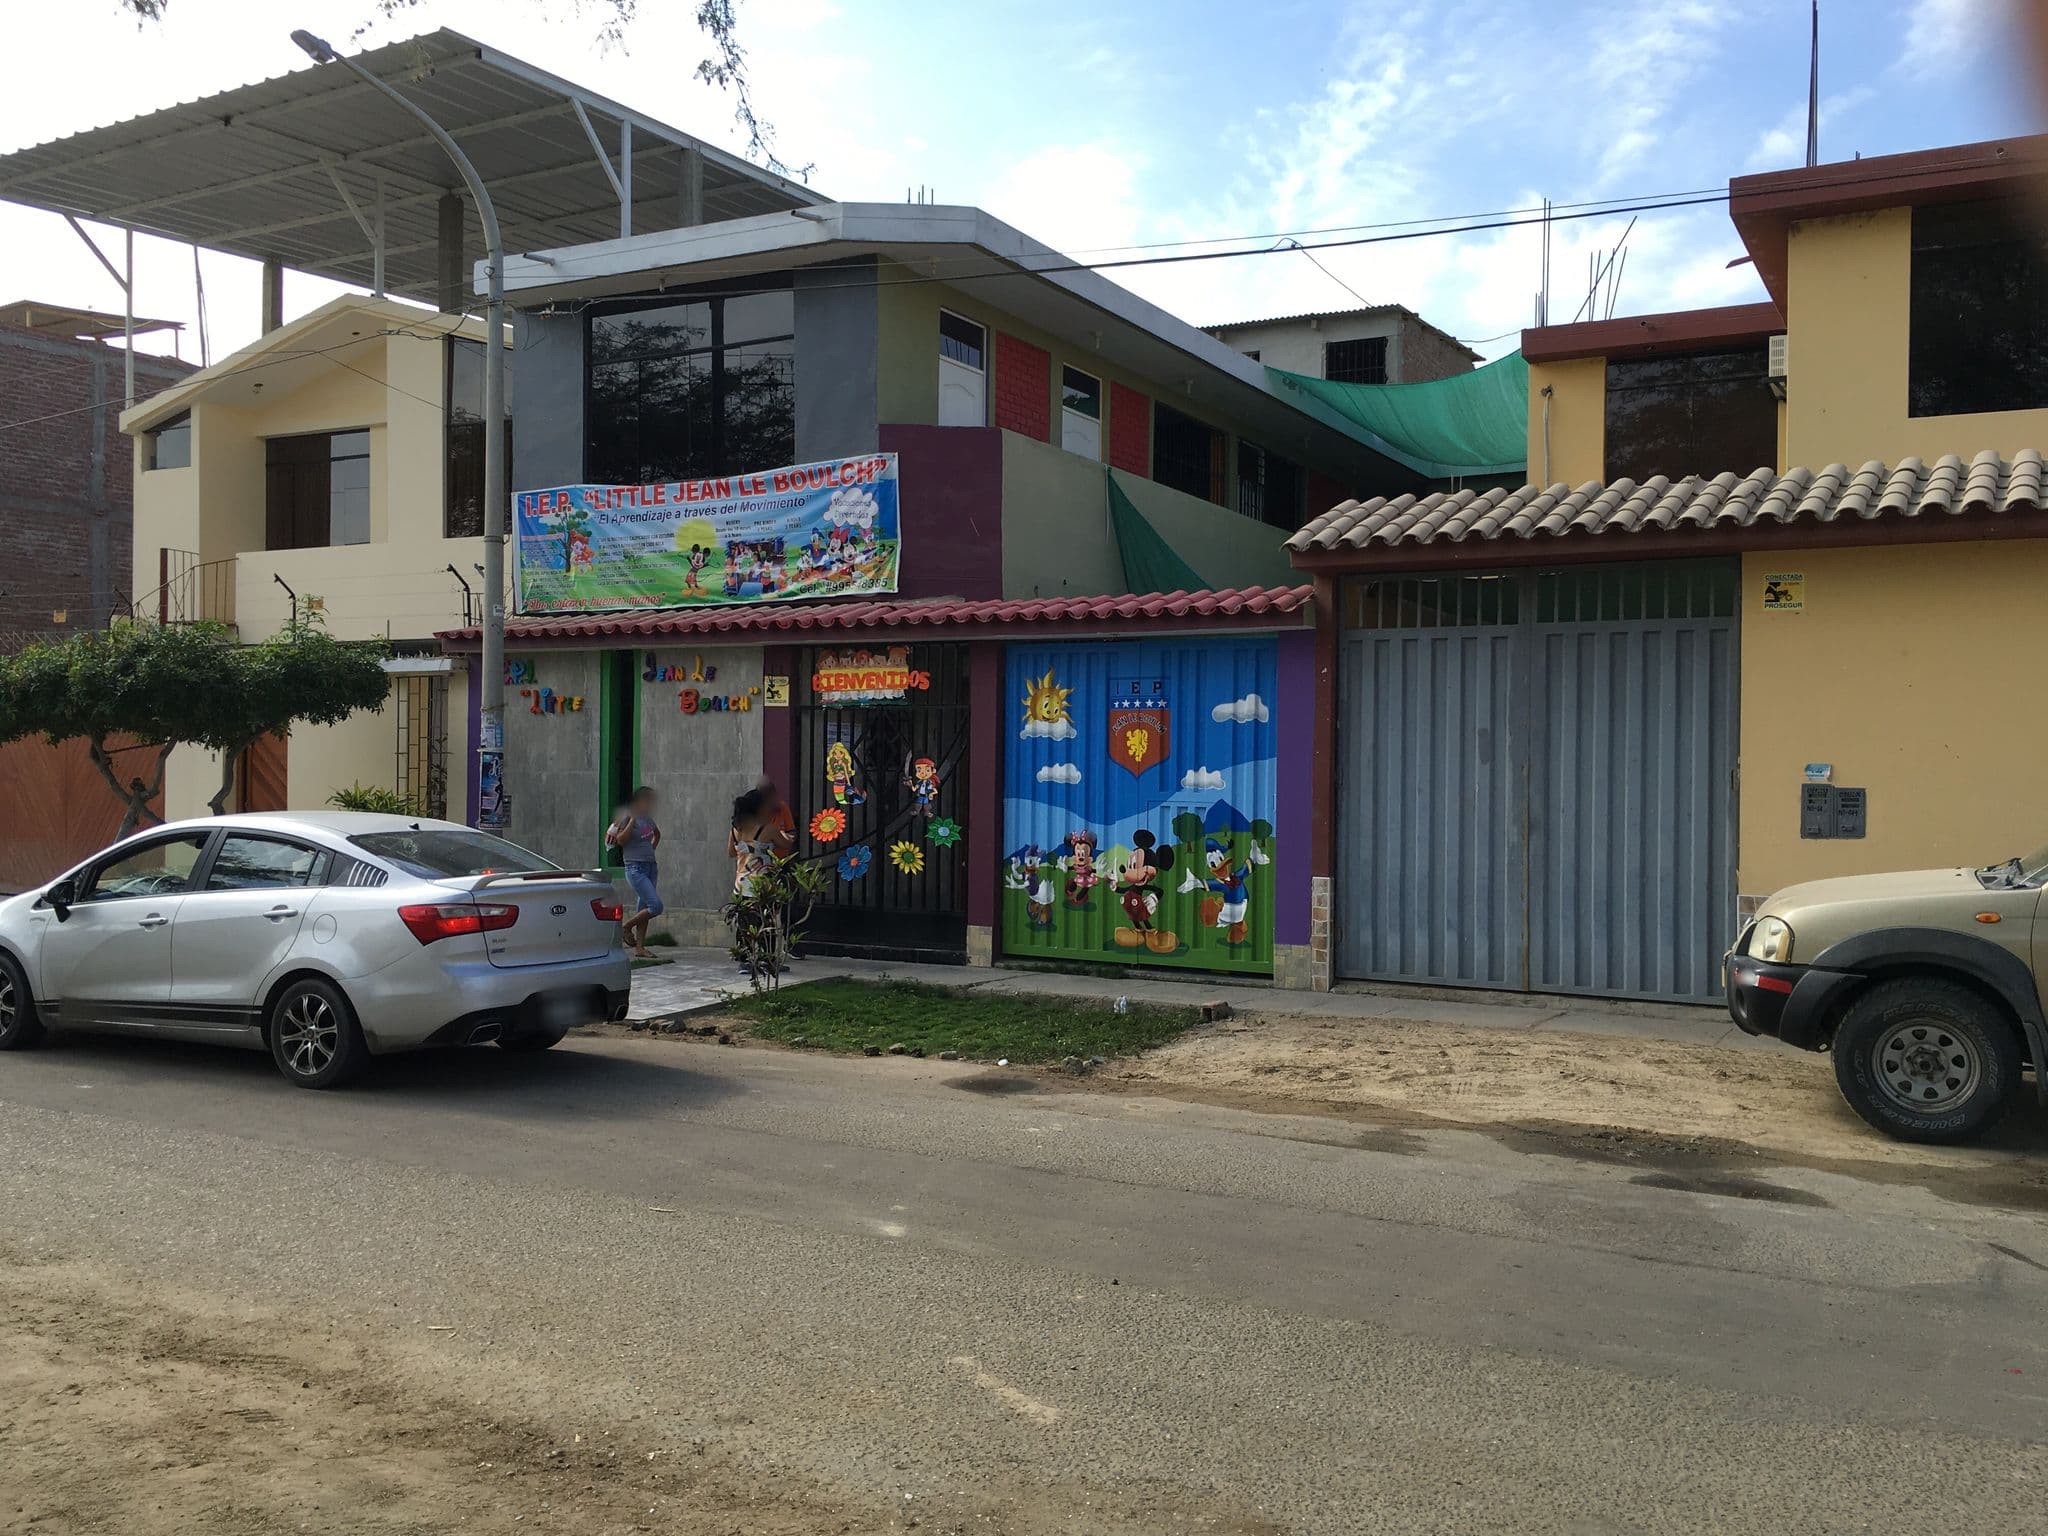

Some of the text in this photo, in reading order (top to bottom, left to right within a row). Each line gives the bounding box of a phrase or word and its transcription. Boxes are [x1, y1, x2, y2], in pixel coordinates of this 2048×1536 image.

[525, 492, 572, 517] I.E.P.
[672, 477, 732, 503] JEAN
[737, 475, 767, 497] LE
[611, 509, 672, 526] Aprendizaje
[674, 512, 681, 520] a
[683, 503, 717, 519] través
[720, 501, 737, 515] del
[811, 670, 931, 692] BIENVENIDOS
